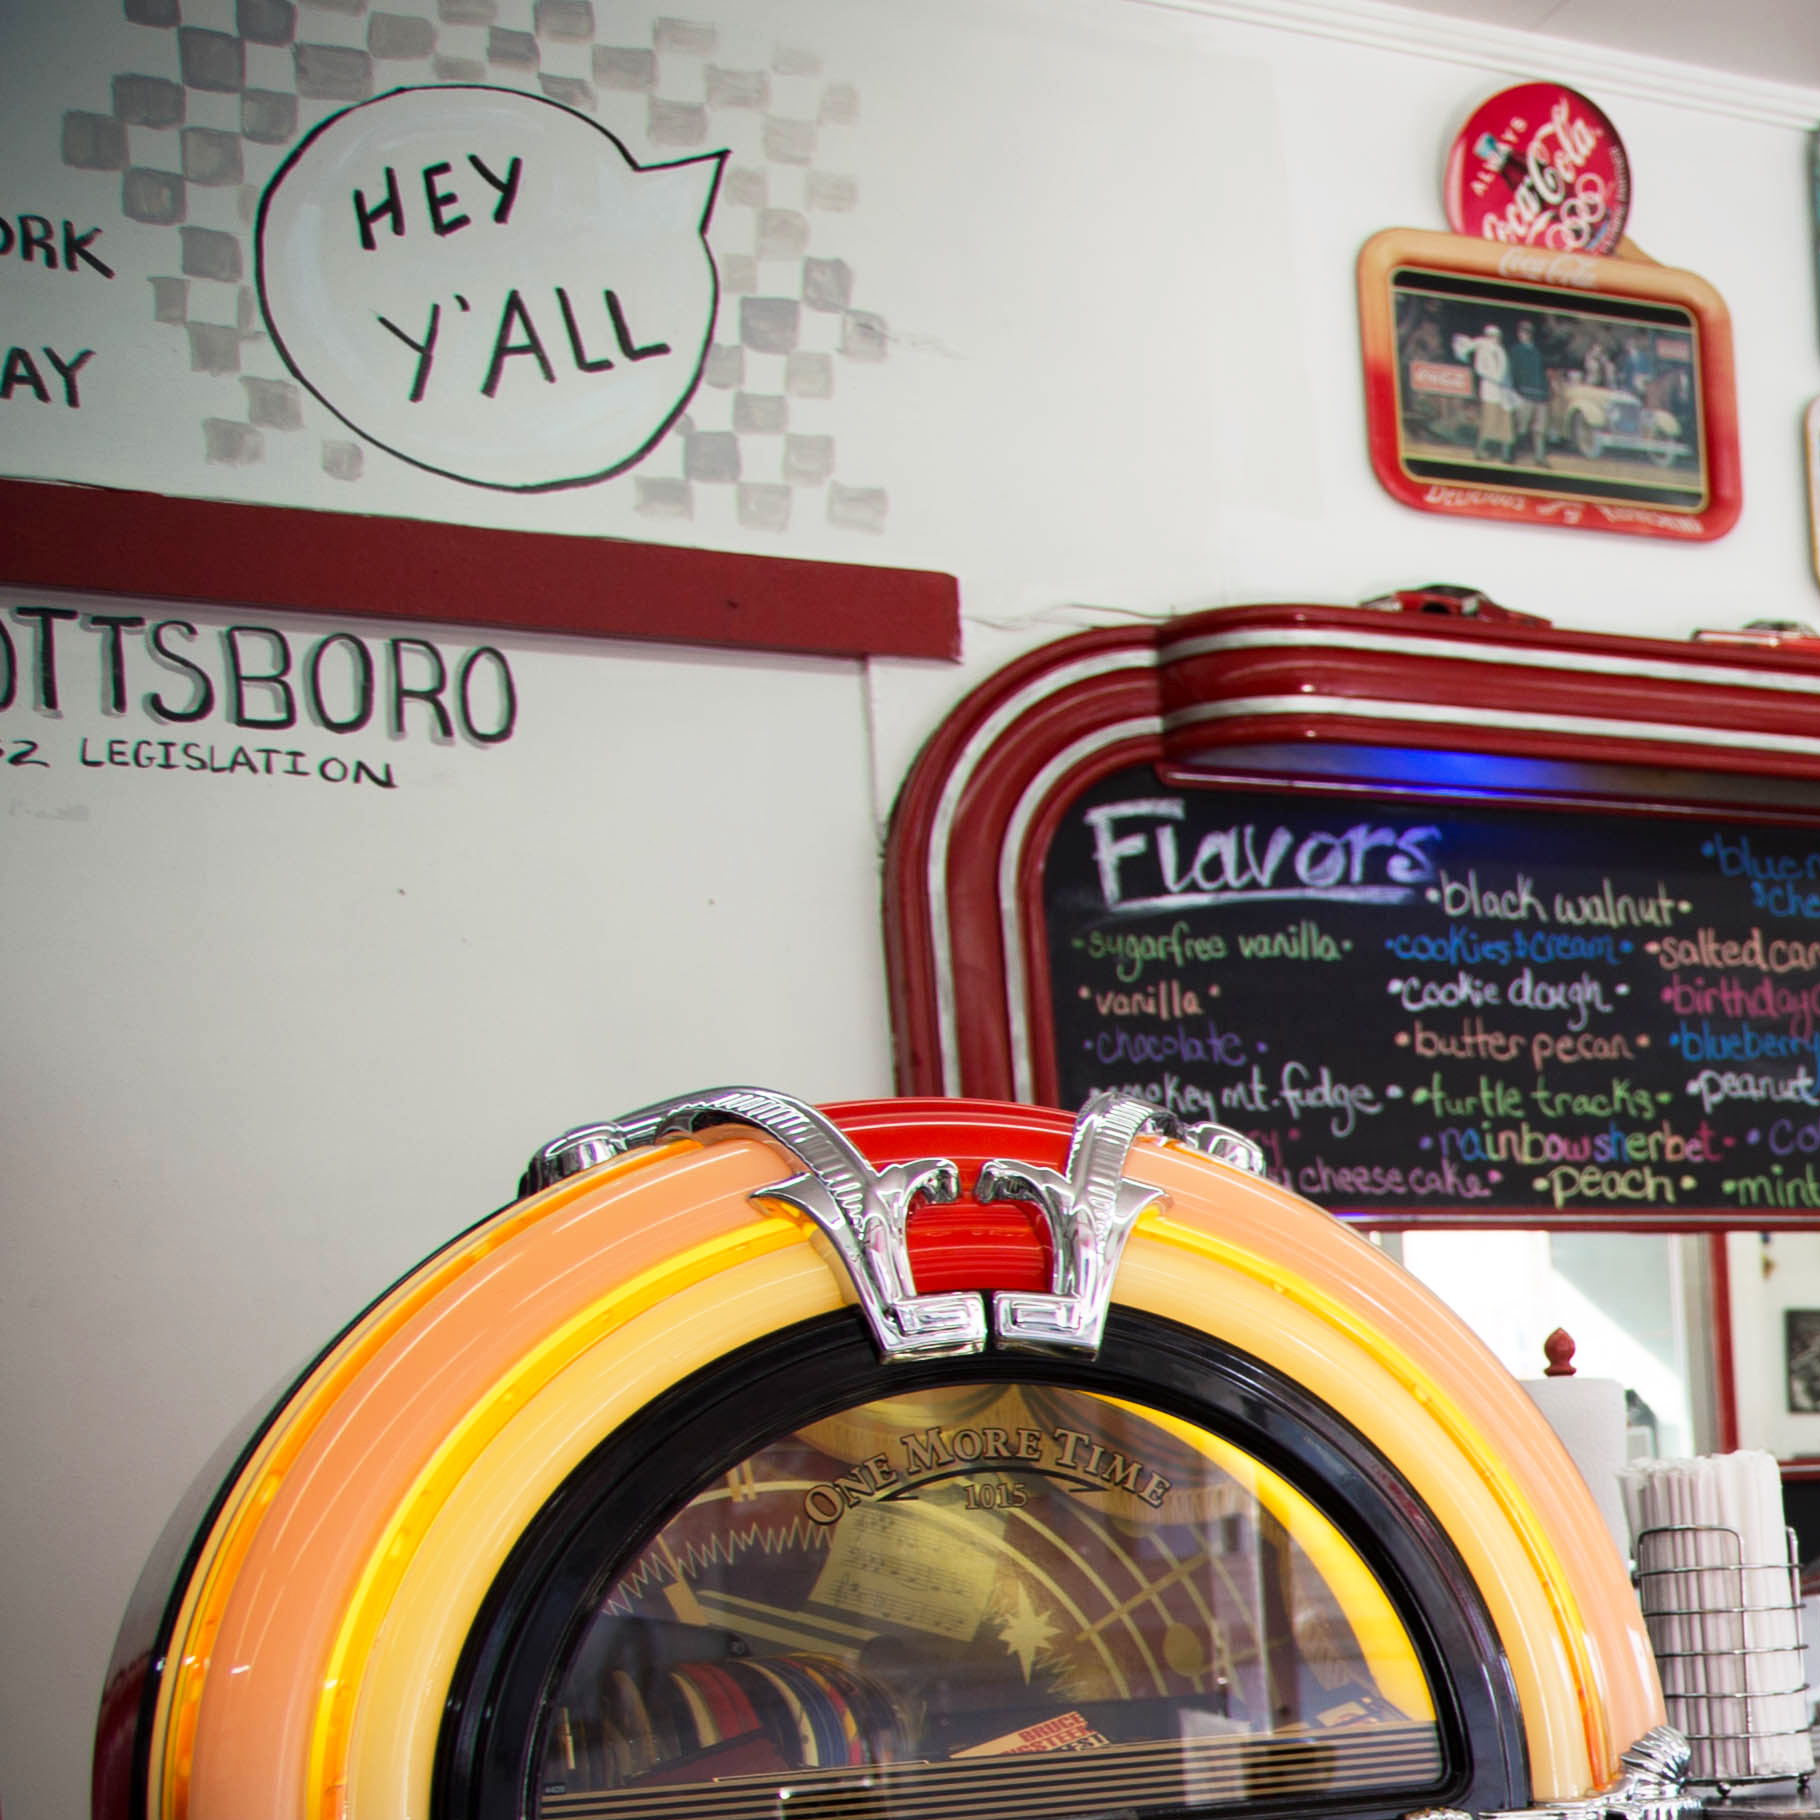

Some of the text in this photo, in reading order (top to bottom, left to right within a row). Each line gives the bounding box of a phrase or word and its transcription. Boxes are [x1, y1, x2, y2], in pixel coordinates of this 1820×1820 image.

[353, 155, 523, 251] HEY
[377, 287, 672, 403] Y'ALL
[79, 737, 400, 790] LEGISLATION
[1084, 797, 1442, 904] Flavors
[1714, 831, 1799, 881] blue
[1440, 867, 1676, 929] black walnut
[1238, 921, 1343, 962] vanilla
[1658, 926, 1768, 973] salted
[1096, 979, 1204, 1021] vanilla
[1508, 966, 1615, 1033] dough
[1098, 1021, 1247, 1066] chocolate
[1414, 1015, 1636, 1072] butter pecan
[1281, 1060, 1384, 1139] fudge
[1426, 1070, 1656, 1120] turtle tracks
[1700, 1066, 1819, 1116] peanut
[1439, 1119, 1722, 1165] rainbow sherbet
[1549, 1164, 1677, 1211] peach
[964, 1483, 1028, 1510] 1015
[1017, 1711, 1086, 1743] BRUCE
